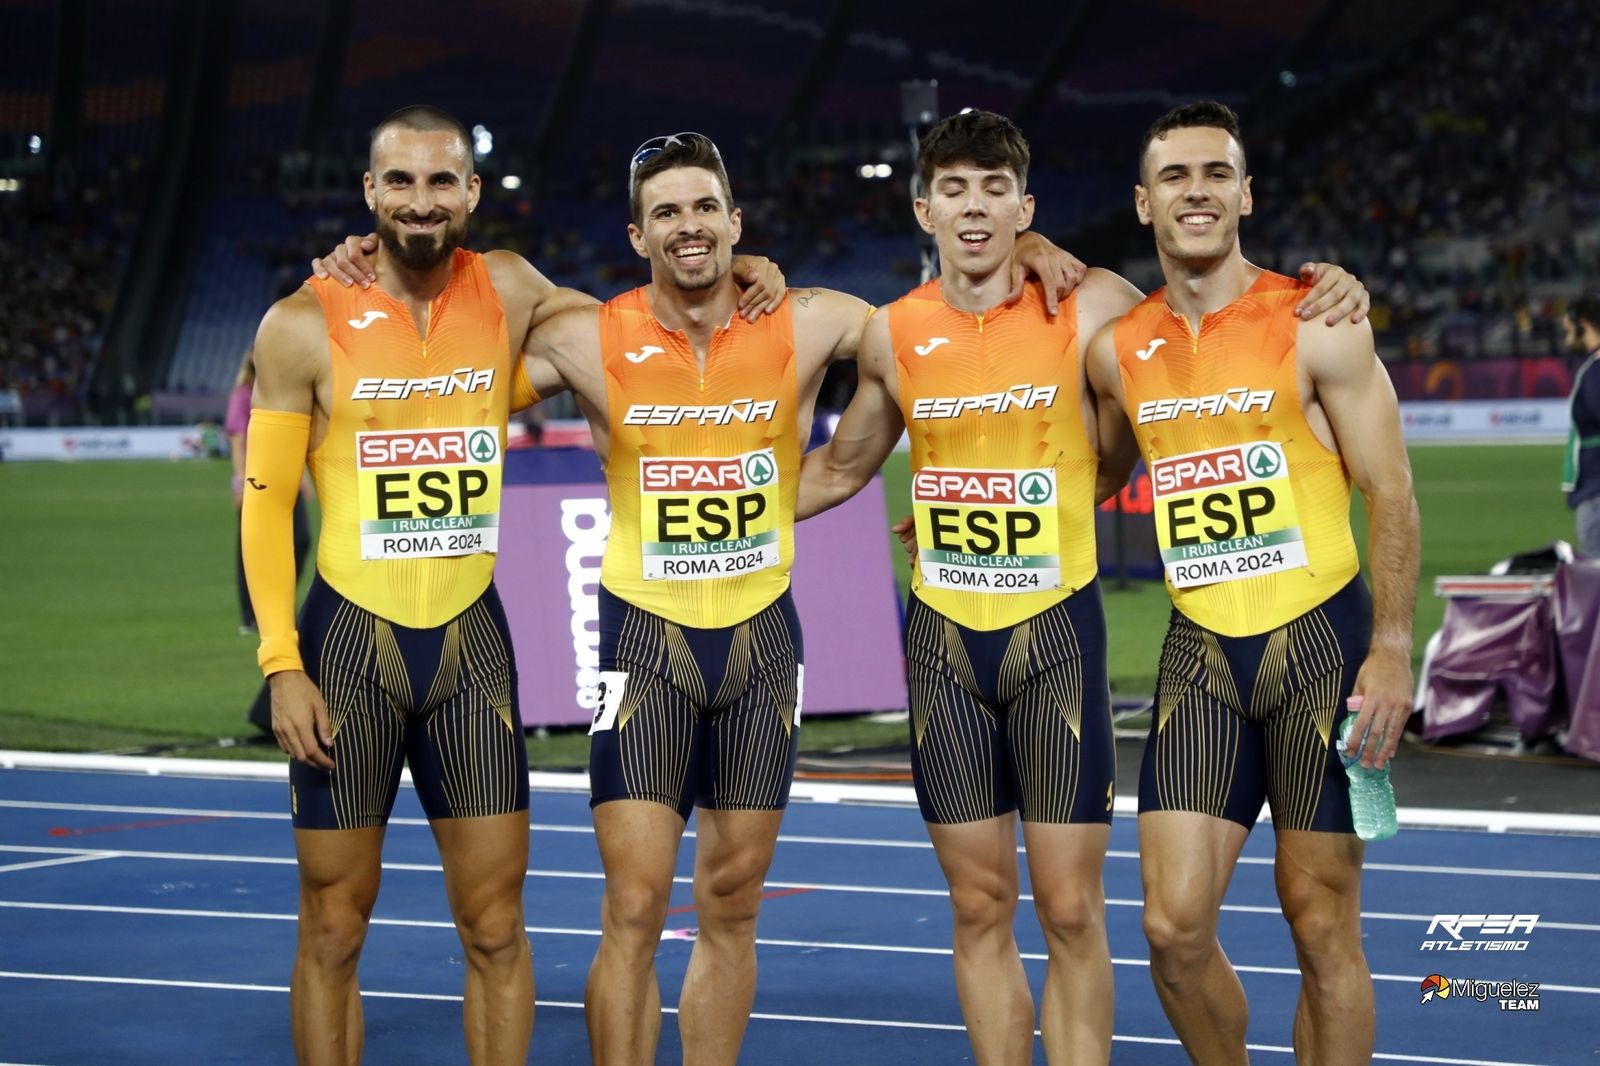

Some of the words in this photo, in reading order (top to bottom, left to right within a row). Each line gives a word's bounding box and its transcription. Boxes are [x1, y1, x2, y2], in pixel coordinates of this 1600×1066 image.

[350, 367, 496, 400] ESPAÑA
[623, 398, 778, 426] ESPAÑA
[912, 383, 1059, 419] ESPAÑA
[1137, 387, 1276, 425] ESPAÑA
[362, 435, 464, 463] SPAR
[645, 463, 743, 488] SPAR
[1156, 453, 1243, 492] SPAR
[376, 469, 489, 520] ESP
[916, 474, 1014, 500] SPAR
[399, 519, 430, 531] RUN
[657, 492, 766, 543] ESP
[929, 507, 1041, 556] ESP
[1167, 486, 1276, 549] ESP
[383, 537, 443, 554] ROMA
[447, 533, 482, 550] 2024
[678, 542, 708, 554] RUN
[1189, 543, 1218, 558] RUN
[663, 559, 721, 575] ROMA
[725, 550, 764, 572] 2024
[951, 554, 977, 565] RUN
[1175, 559, 1233, 582] ROMA
[1236, 550, 1285, 573] 2024
[938, 568, 990, 588] ROMA
[993, 573, 1040, 588] 2024
